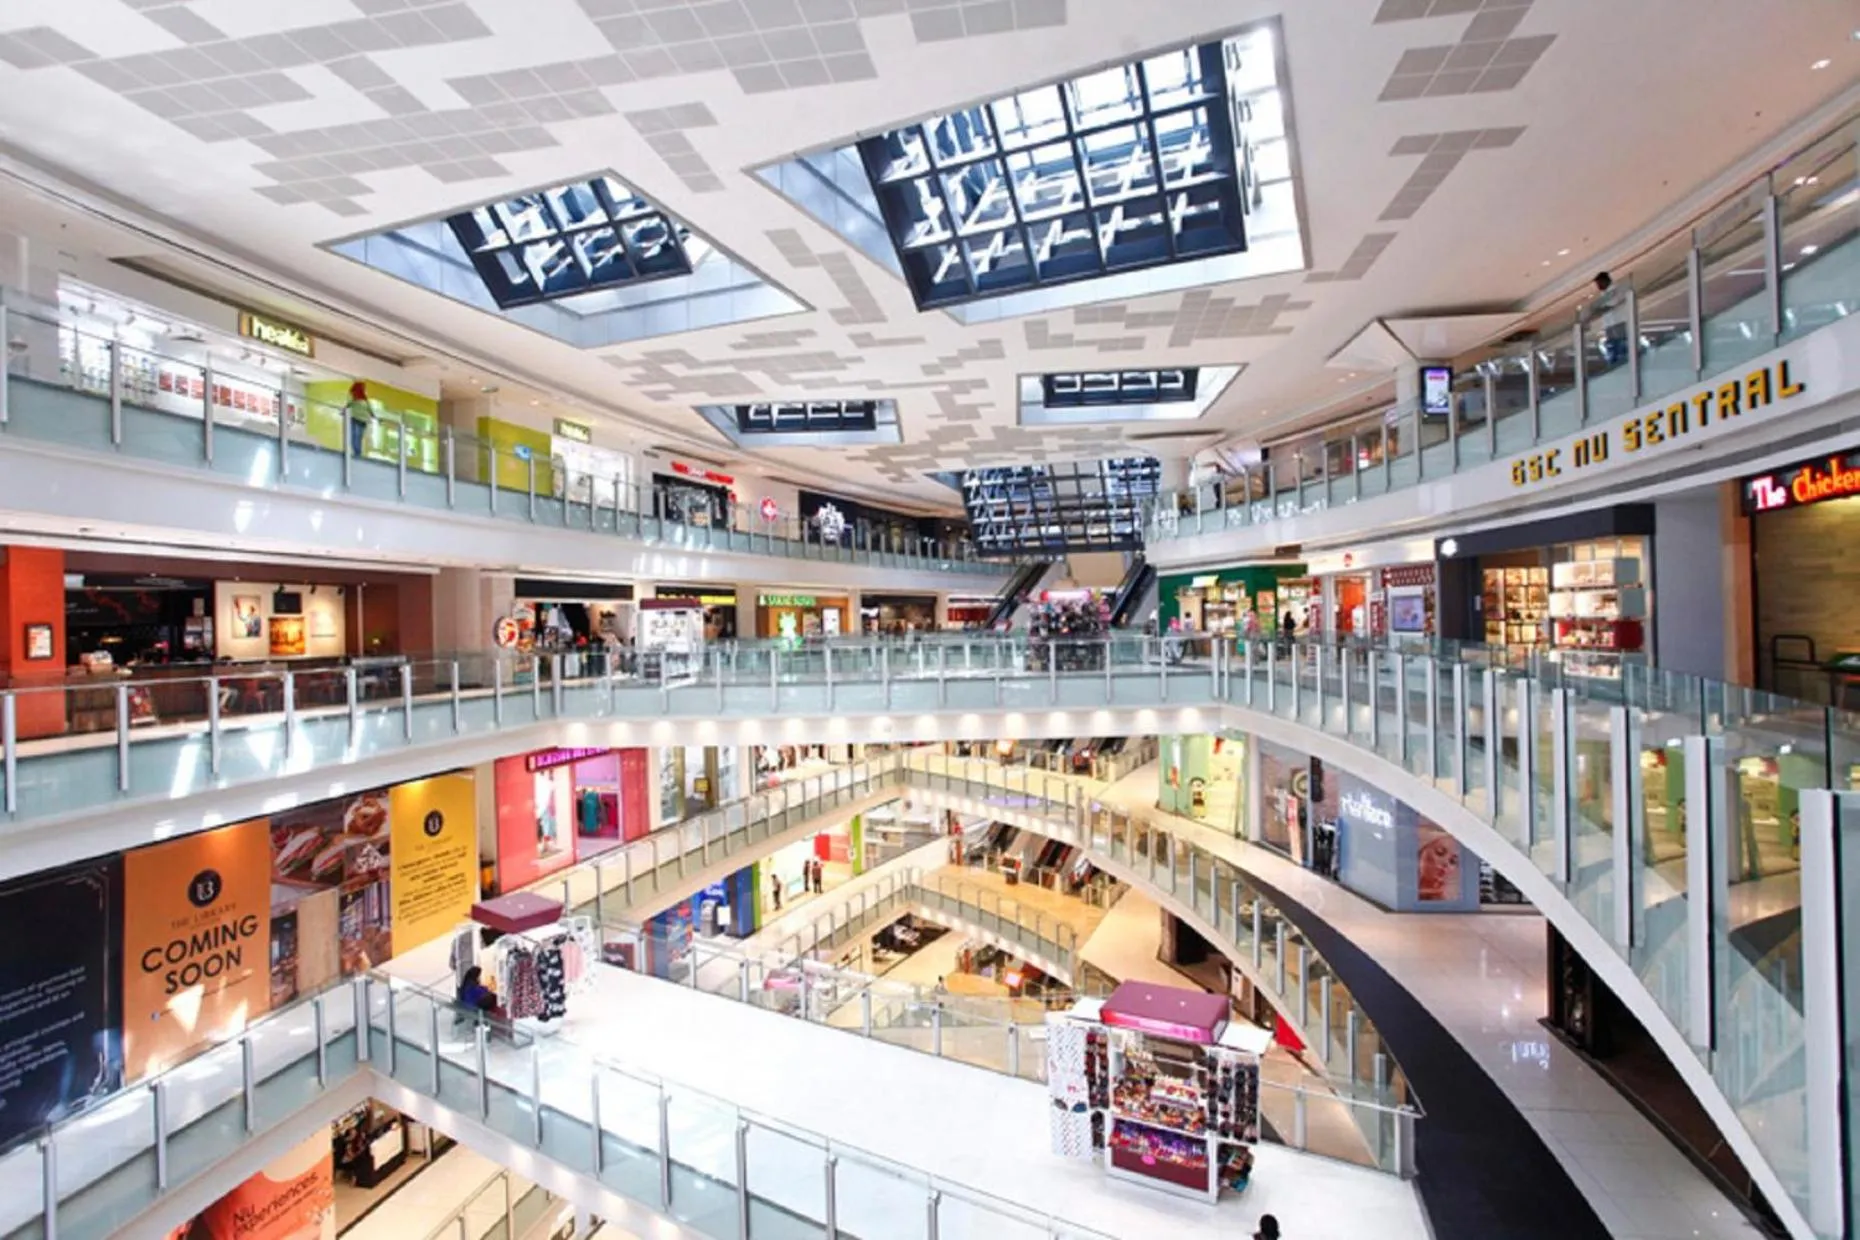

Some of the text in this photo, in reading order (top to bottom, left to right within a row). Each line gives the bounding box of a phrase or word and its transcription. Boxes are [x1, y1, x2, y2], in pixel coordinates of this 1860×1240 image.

[1512, 360, 1805, 486] GSC NU SENTRAL
[1752, 475, 1787, 510] The
[141, 915, 258, 973] COMING
[165, 945, 242, 995] SOON
